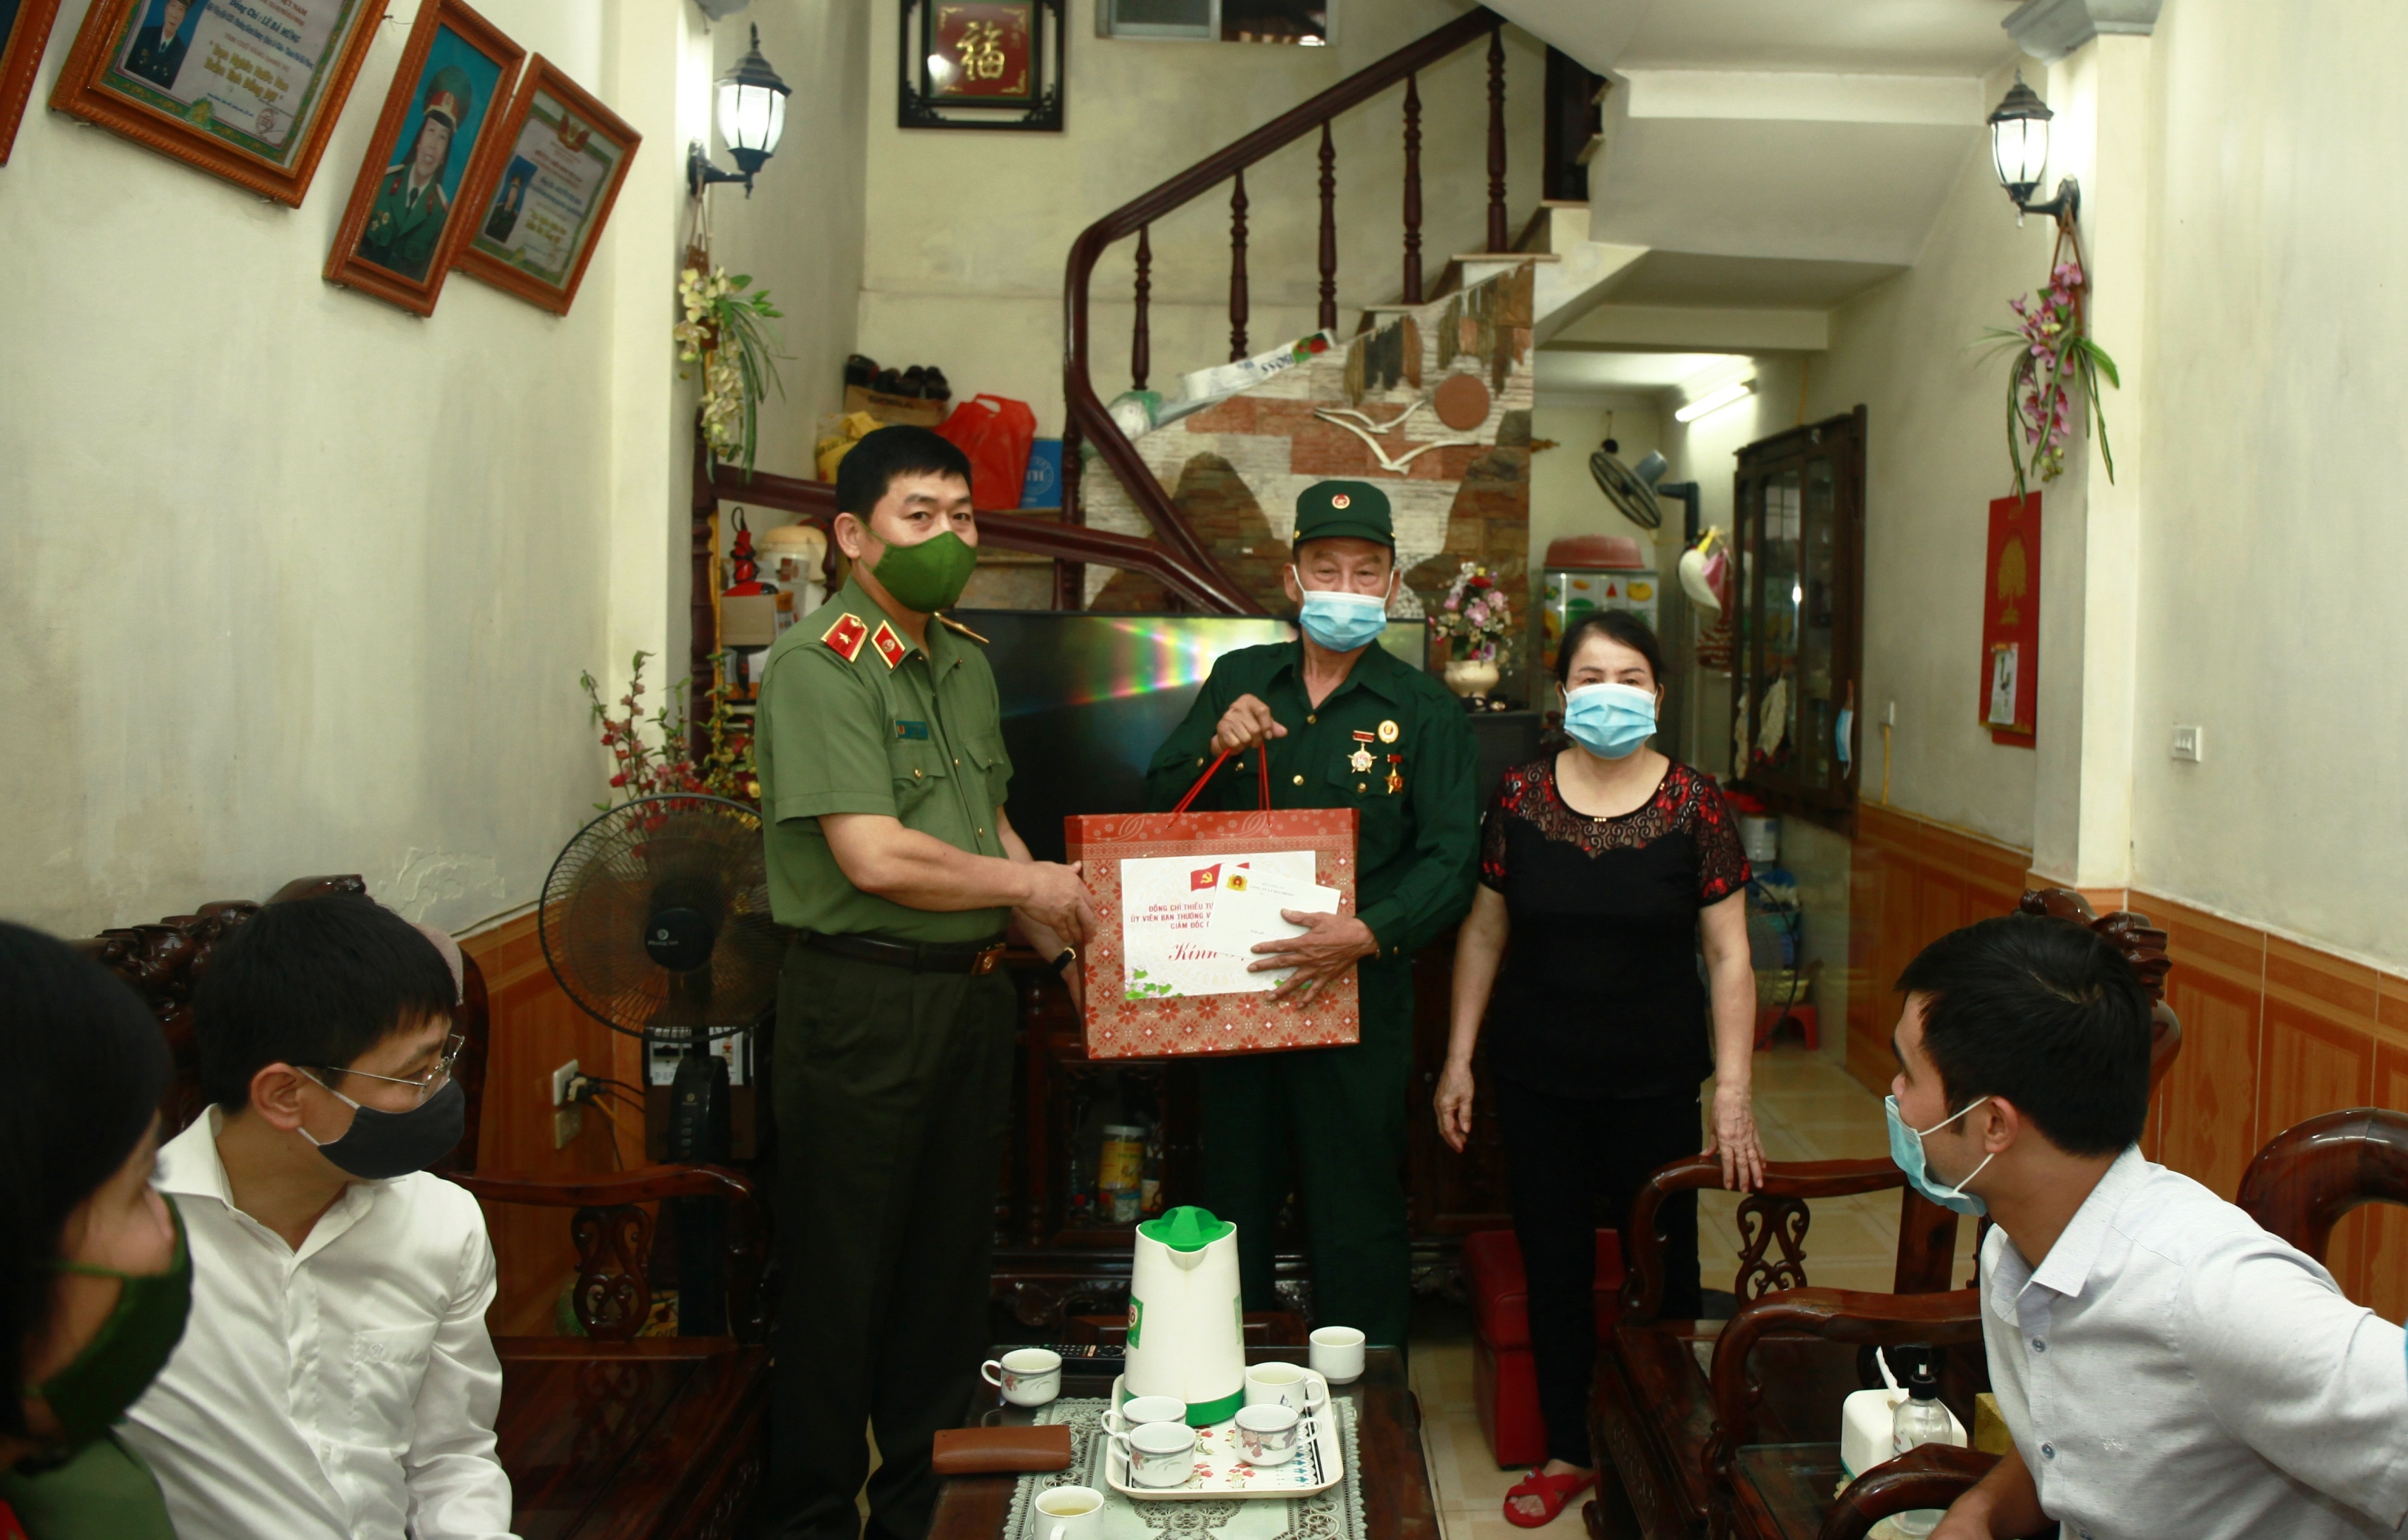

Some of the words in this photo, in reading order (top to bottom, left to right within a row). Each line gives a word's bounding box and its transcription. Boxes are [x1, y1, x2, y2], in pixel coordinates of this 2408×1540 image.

[956, 21, 1004, 81] 福
[1149, 903, 1168, 912] ĐỒNG
[1131, 914, 1140, 923] ỦY
[1143, 913, 1158, 922] VIÊN
[1177, 912, 1203, 920] THƯỜNG
[1170, 920, 1188, 929] GIÁM
[1191, 920, 1204, 929] ĐỐC
